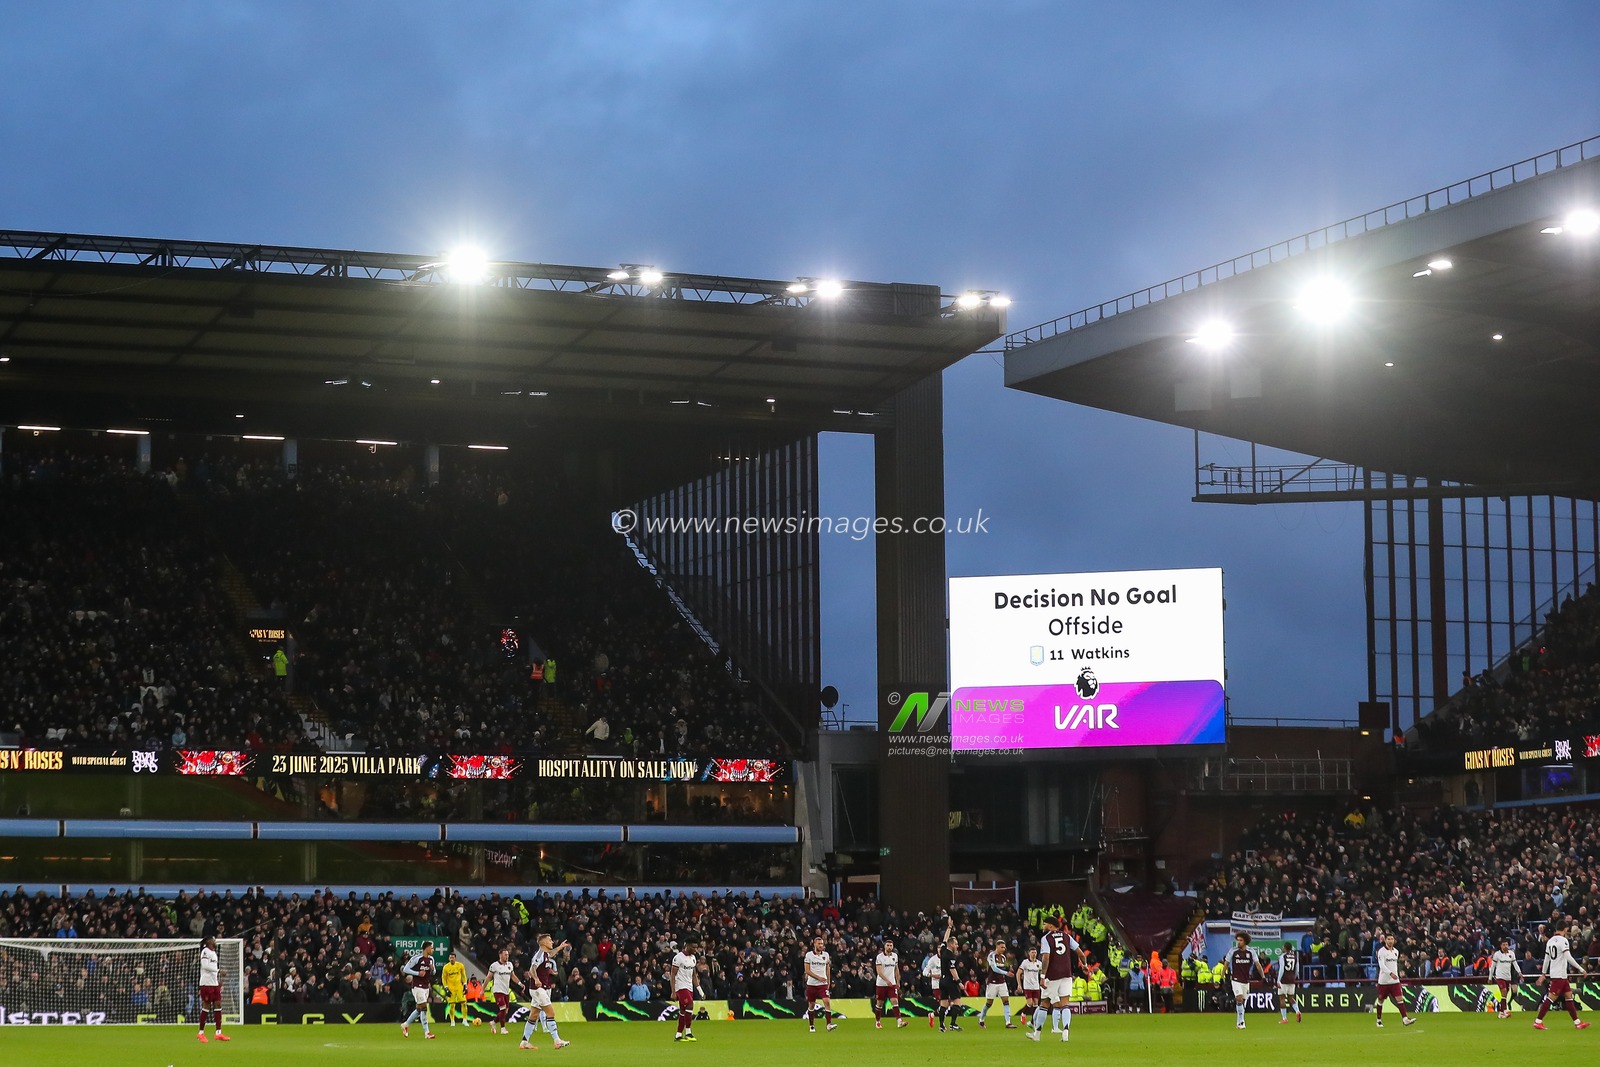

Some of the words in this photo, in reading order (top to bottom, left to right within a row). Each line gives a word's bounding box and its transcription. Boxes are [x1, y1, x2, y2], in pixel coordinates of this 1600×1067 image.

[994, 588, 1084, 610] Decision
[1091, 588, 1120, 606] No
[1126, 584, 1177, 605] Goal
[1048, 615, 1123, 636] Offside
[1050, 649, 1064, 661] 11
[1071, 646, 1130, 660] Watkins
[1054, 704, 1120, 730] VAR
[24, 750, 63, 770] ROSES
[131, 750, 158, 764] RIVAL
[272, 755, 287, 773] 23
[289, 755, 317, 775] JUNE
[320, 756, 348, 773] 2025
[351, 757, 385, 774] VILLA
[388, 757, 421, 774] PARK
[1464, 751, 1484, 770] GUNS
[1491, 747, 1515, 767] ROSES
[538, 759, 616, 778] HOSPITALITY
[620, 760, 635, 778] ON
[638, 760, 667, 778] SALE
[669, 760, 697, 778] NOW
[395, 940, 418, 948] FIRST
[1055, 937, 1067, 955] 5
[1253, 946, 1272, 956] Fire
